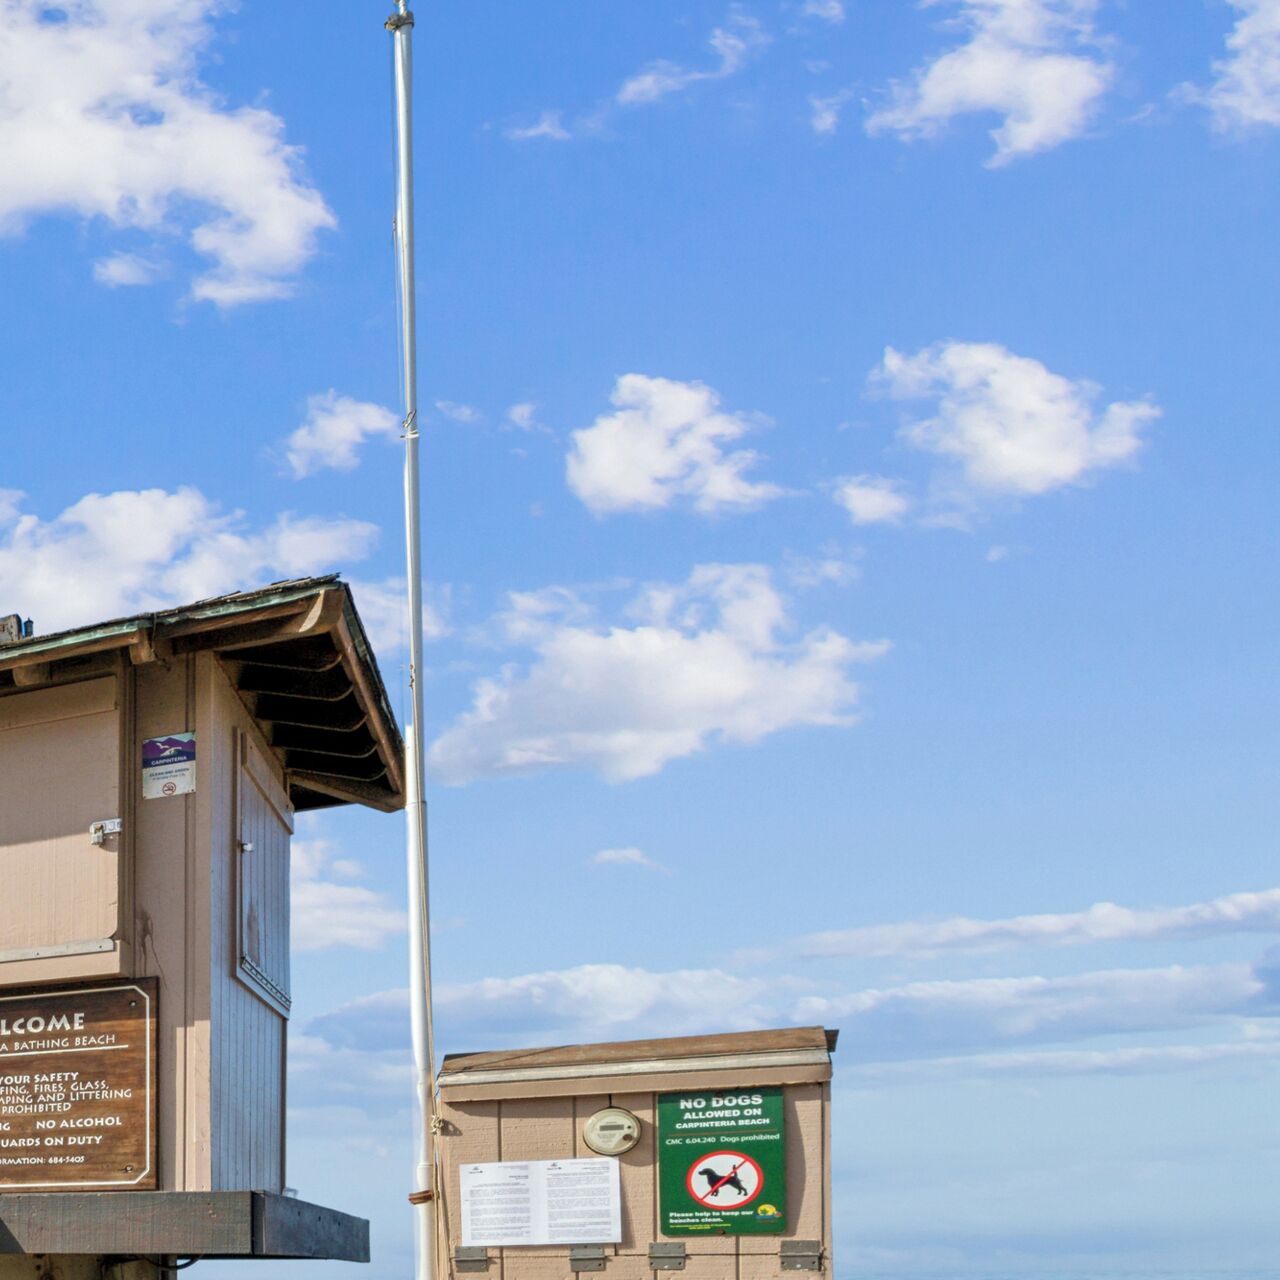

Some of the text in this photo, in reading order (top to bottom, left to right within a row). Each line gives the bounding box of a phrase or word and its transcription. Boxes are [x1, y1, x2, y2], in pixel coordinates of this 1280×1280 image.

[151, 756, 187, 766] CARPINTERIA
[14, 1038, 69, 1051] BATHING
[74, 1034, 115, 1046] BEACH
[34, 1072, 79, 1083] SAFETY
[34, 1083, 66, 1093] FIRES,
[70, 1080, 109, 1091] GLASS,
[37, 1093, 65, 1103] AND
[70, 1089, 132, 1101] LITTERING
[680, 1094, 763, 1109] NO DOGS
[2, 1102, 72, 1114] PROHIBITED
[683, 1109, 740, 1120] ALLOWED
[36, 1116, 122, 1129] NO ALCOHOL
[676, 1120, 736, 1129] CARPINTERIA
[44, 1137, 63, 1146] ON
[68, 1135, 102, 1145] DUTY
[741, 1133, 780, 1142] prohibited
[48, 1156, 85, 1164] 684-5405
